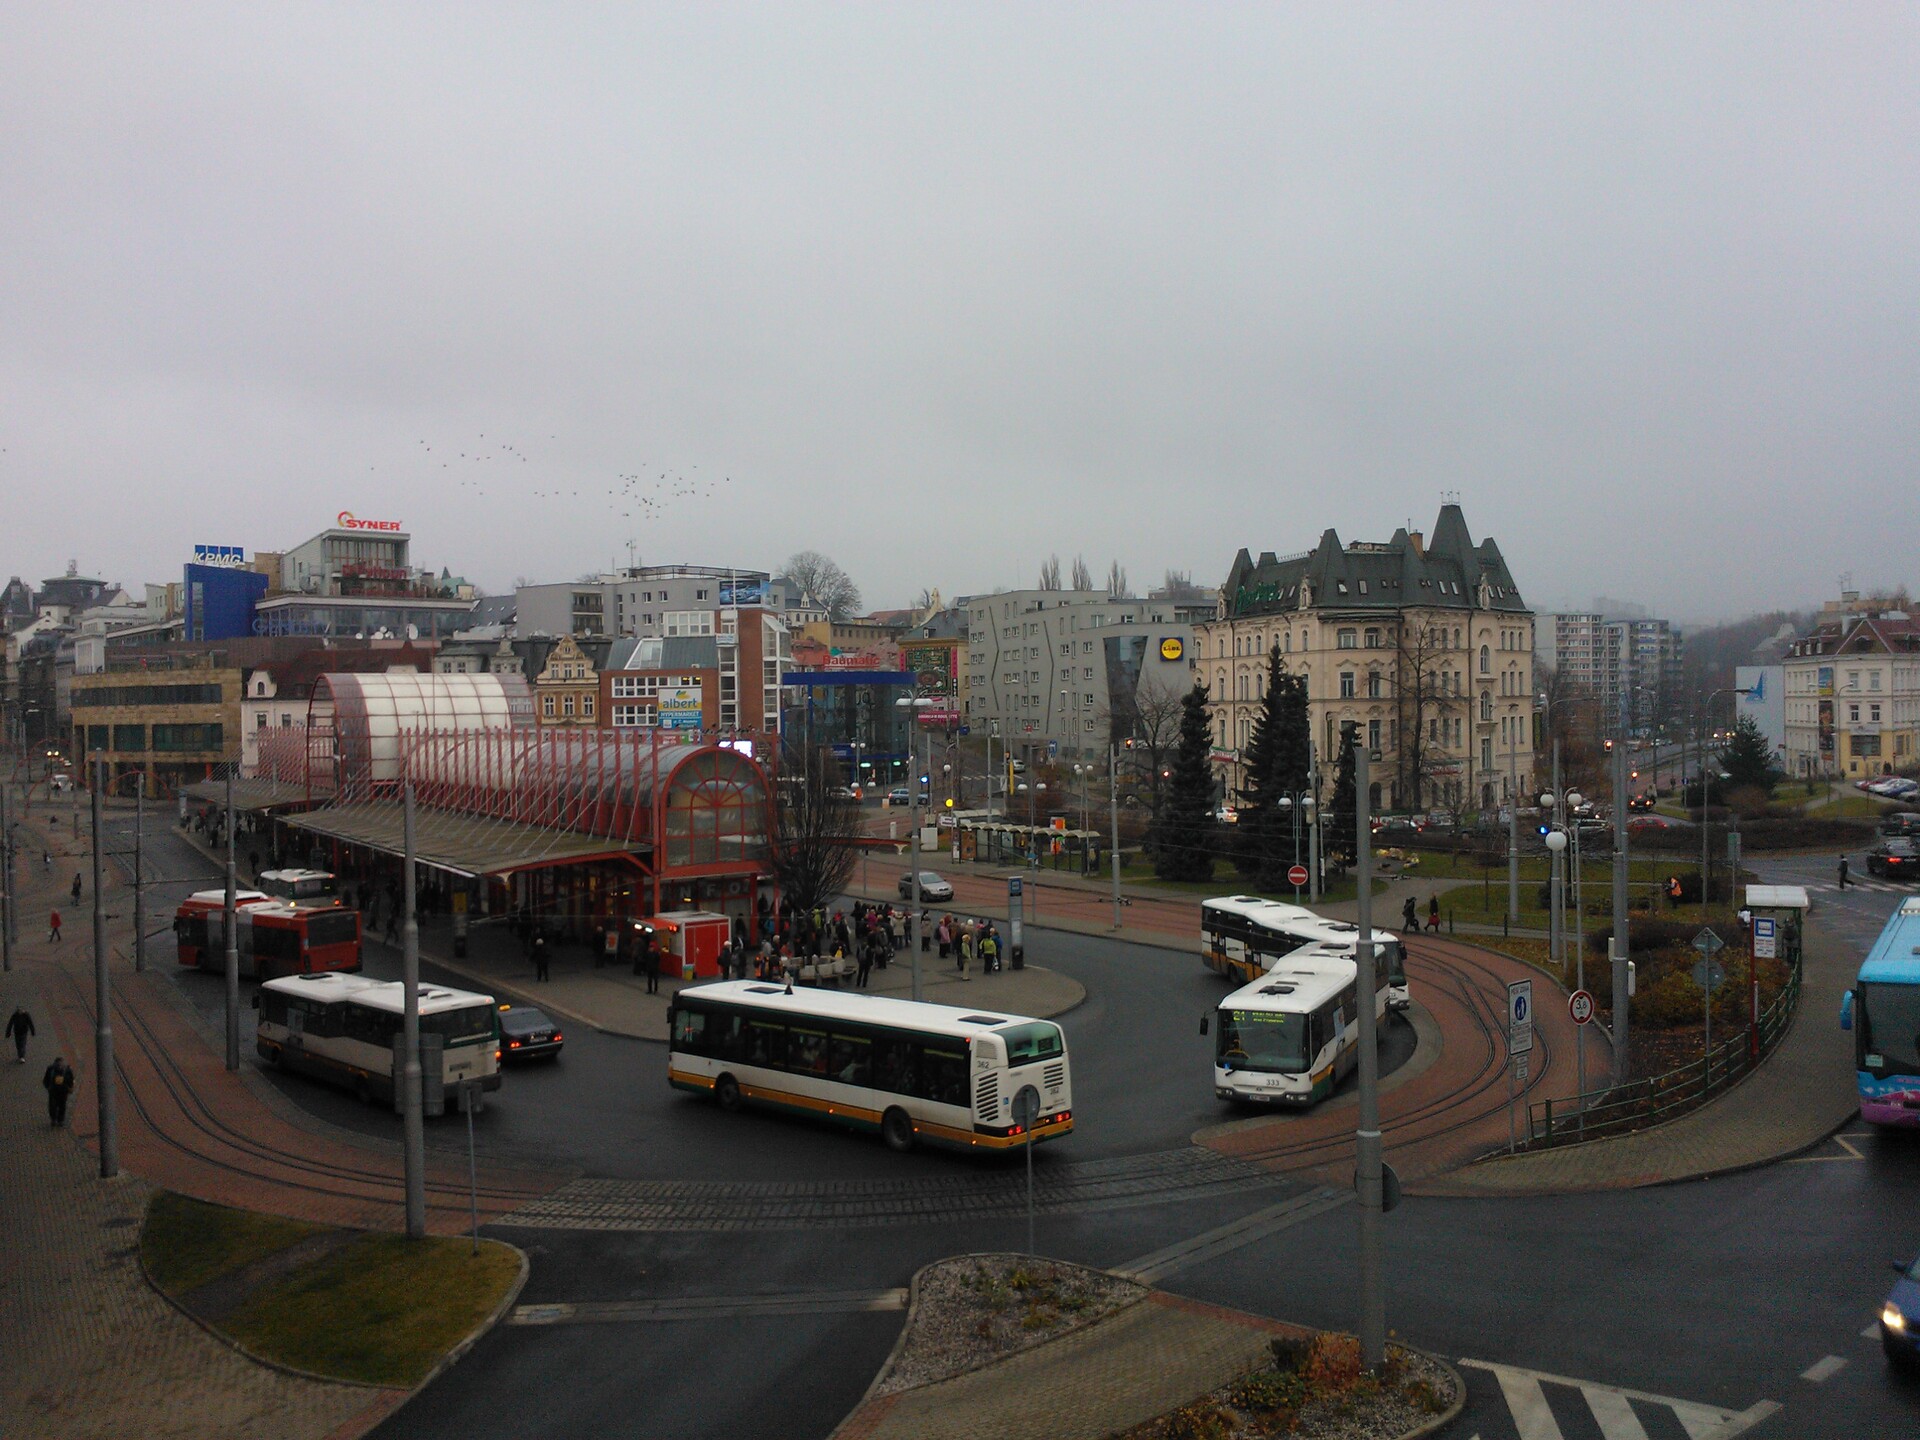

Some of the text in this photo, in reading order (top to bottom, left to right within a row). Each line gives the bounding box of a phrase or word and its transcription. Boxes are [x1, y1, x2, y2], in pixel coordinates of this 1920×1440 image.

[346, 519, 401, 531] SYNER
[192, 552, 241, 566] KPMG
[822, 655, 880, 666] Baumatic
[662, 697, 698, 709] albert
[1266, 1078, 1280, 1087] 333
